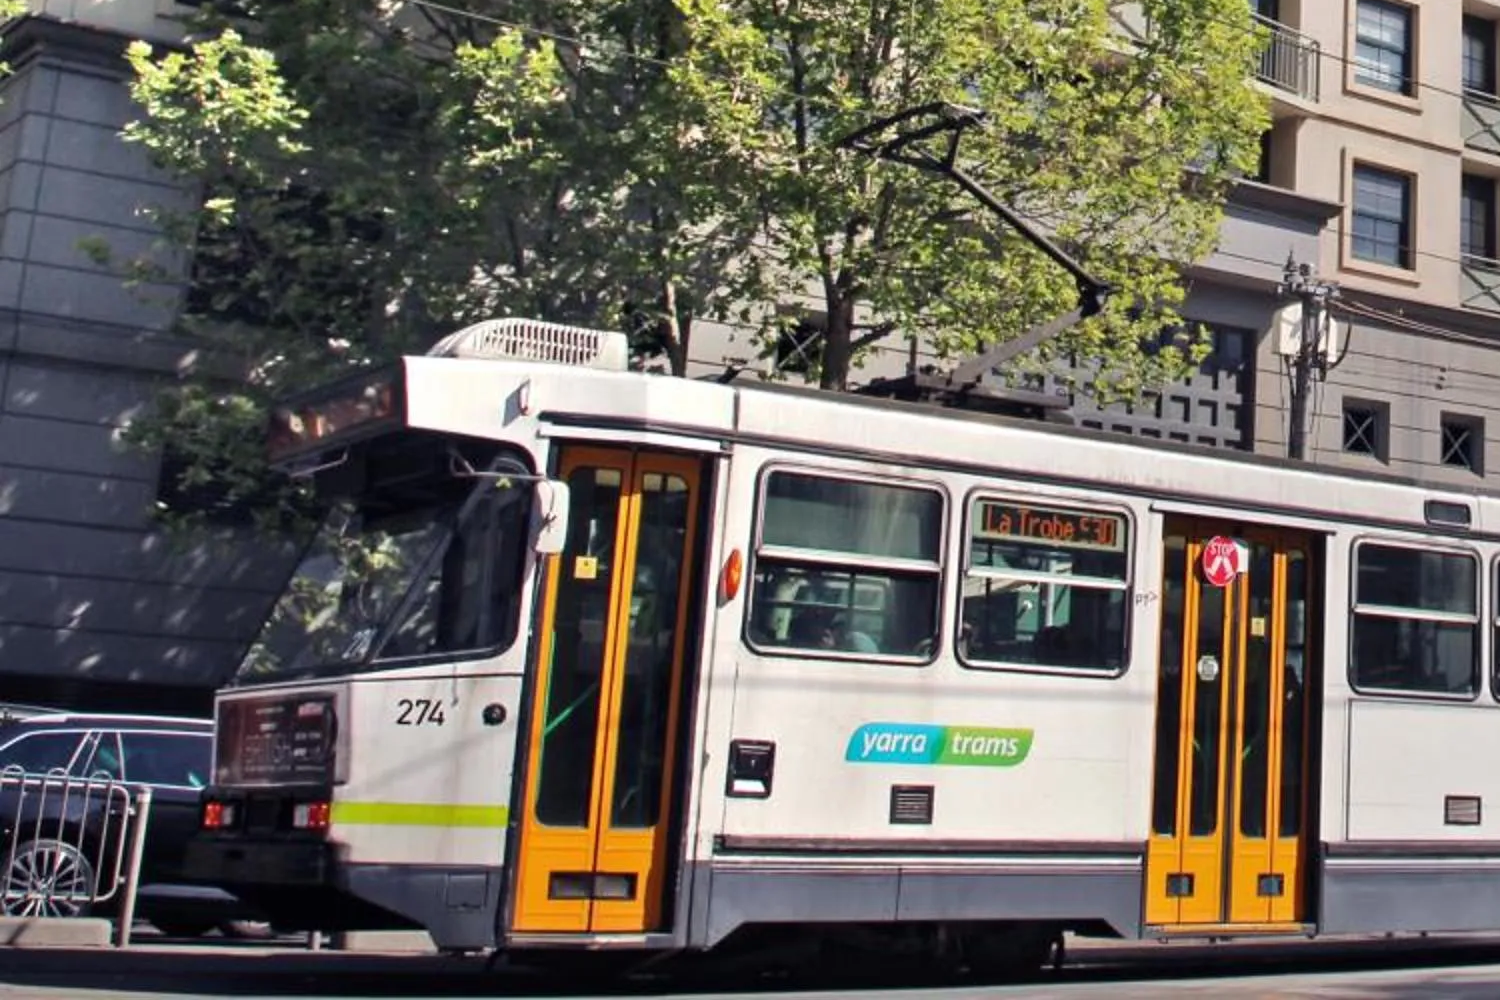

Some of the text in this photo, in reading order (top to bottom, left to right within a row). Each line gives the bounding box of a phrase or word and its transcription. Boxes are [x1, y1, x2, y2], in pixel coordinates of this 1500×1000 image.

[986, 504, 1012, 535] La
[1018, 507, 1074, 541] Trobe
[1209, 543, 1235, 557] STOP
[396, 698, 445, 726] 274
[861, 731, 1020, 758] yarra trams
